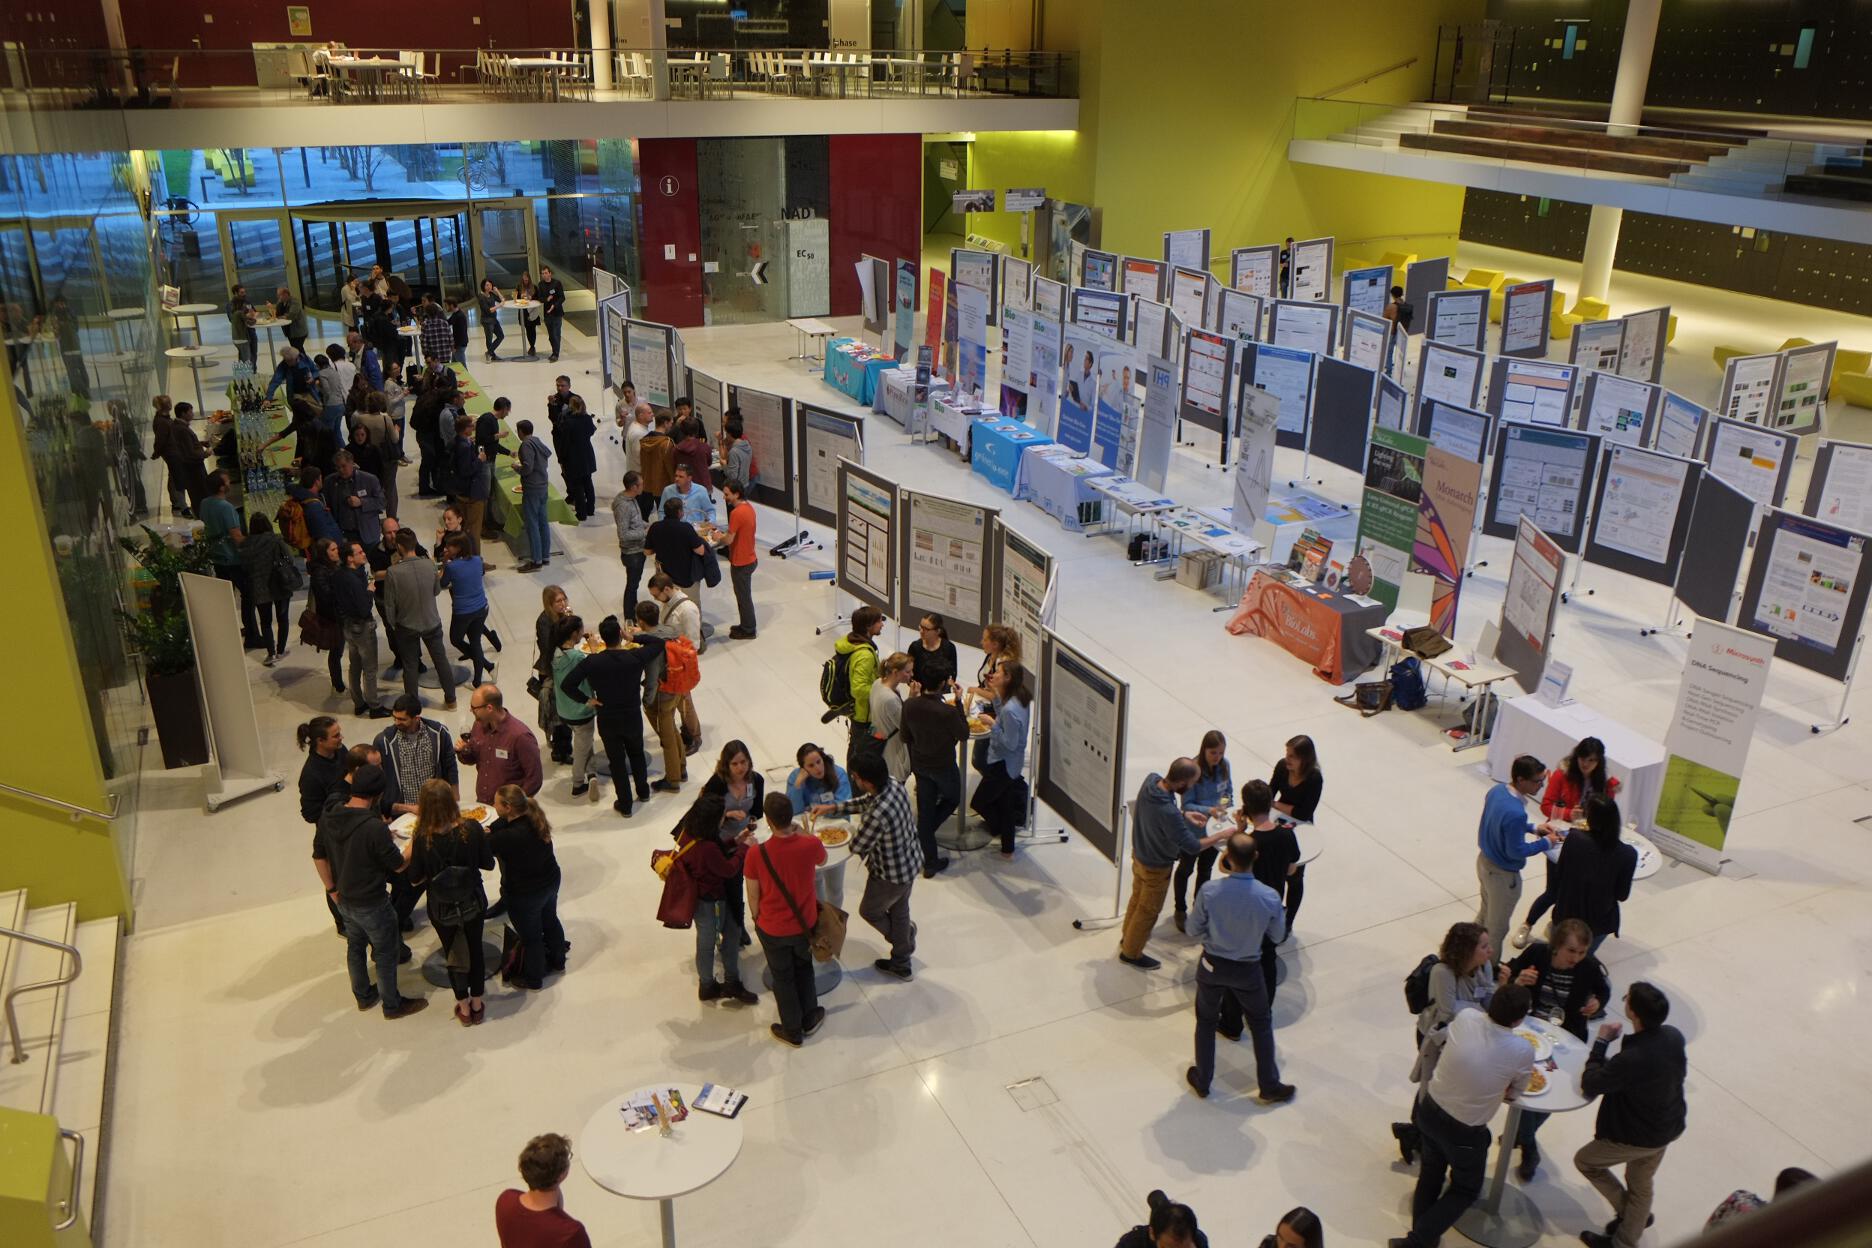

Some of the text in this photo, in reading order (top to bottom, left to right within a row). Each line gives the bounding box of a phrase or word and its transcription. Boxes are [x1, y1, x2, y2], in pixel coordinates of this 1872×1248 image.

[781, 208, 811, 220] NAD
[1437, 481, 1474, 506] Monarch
[1691, 660, 1749, 684] DNA Sequencing
